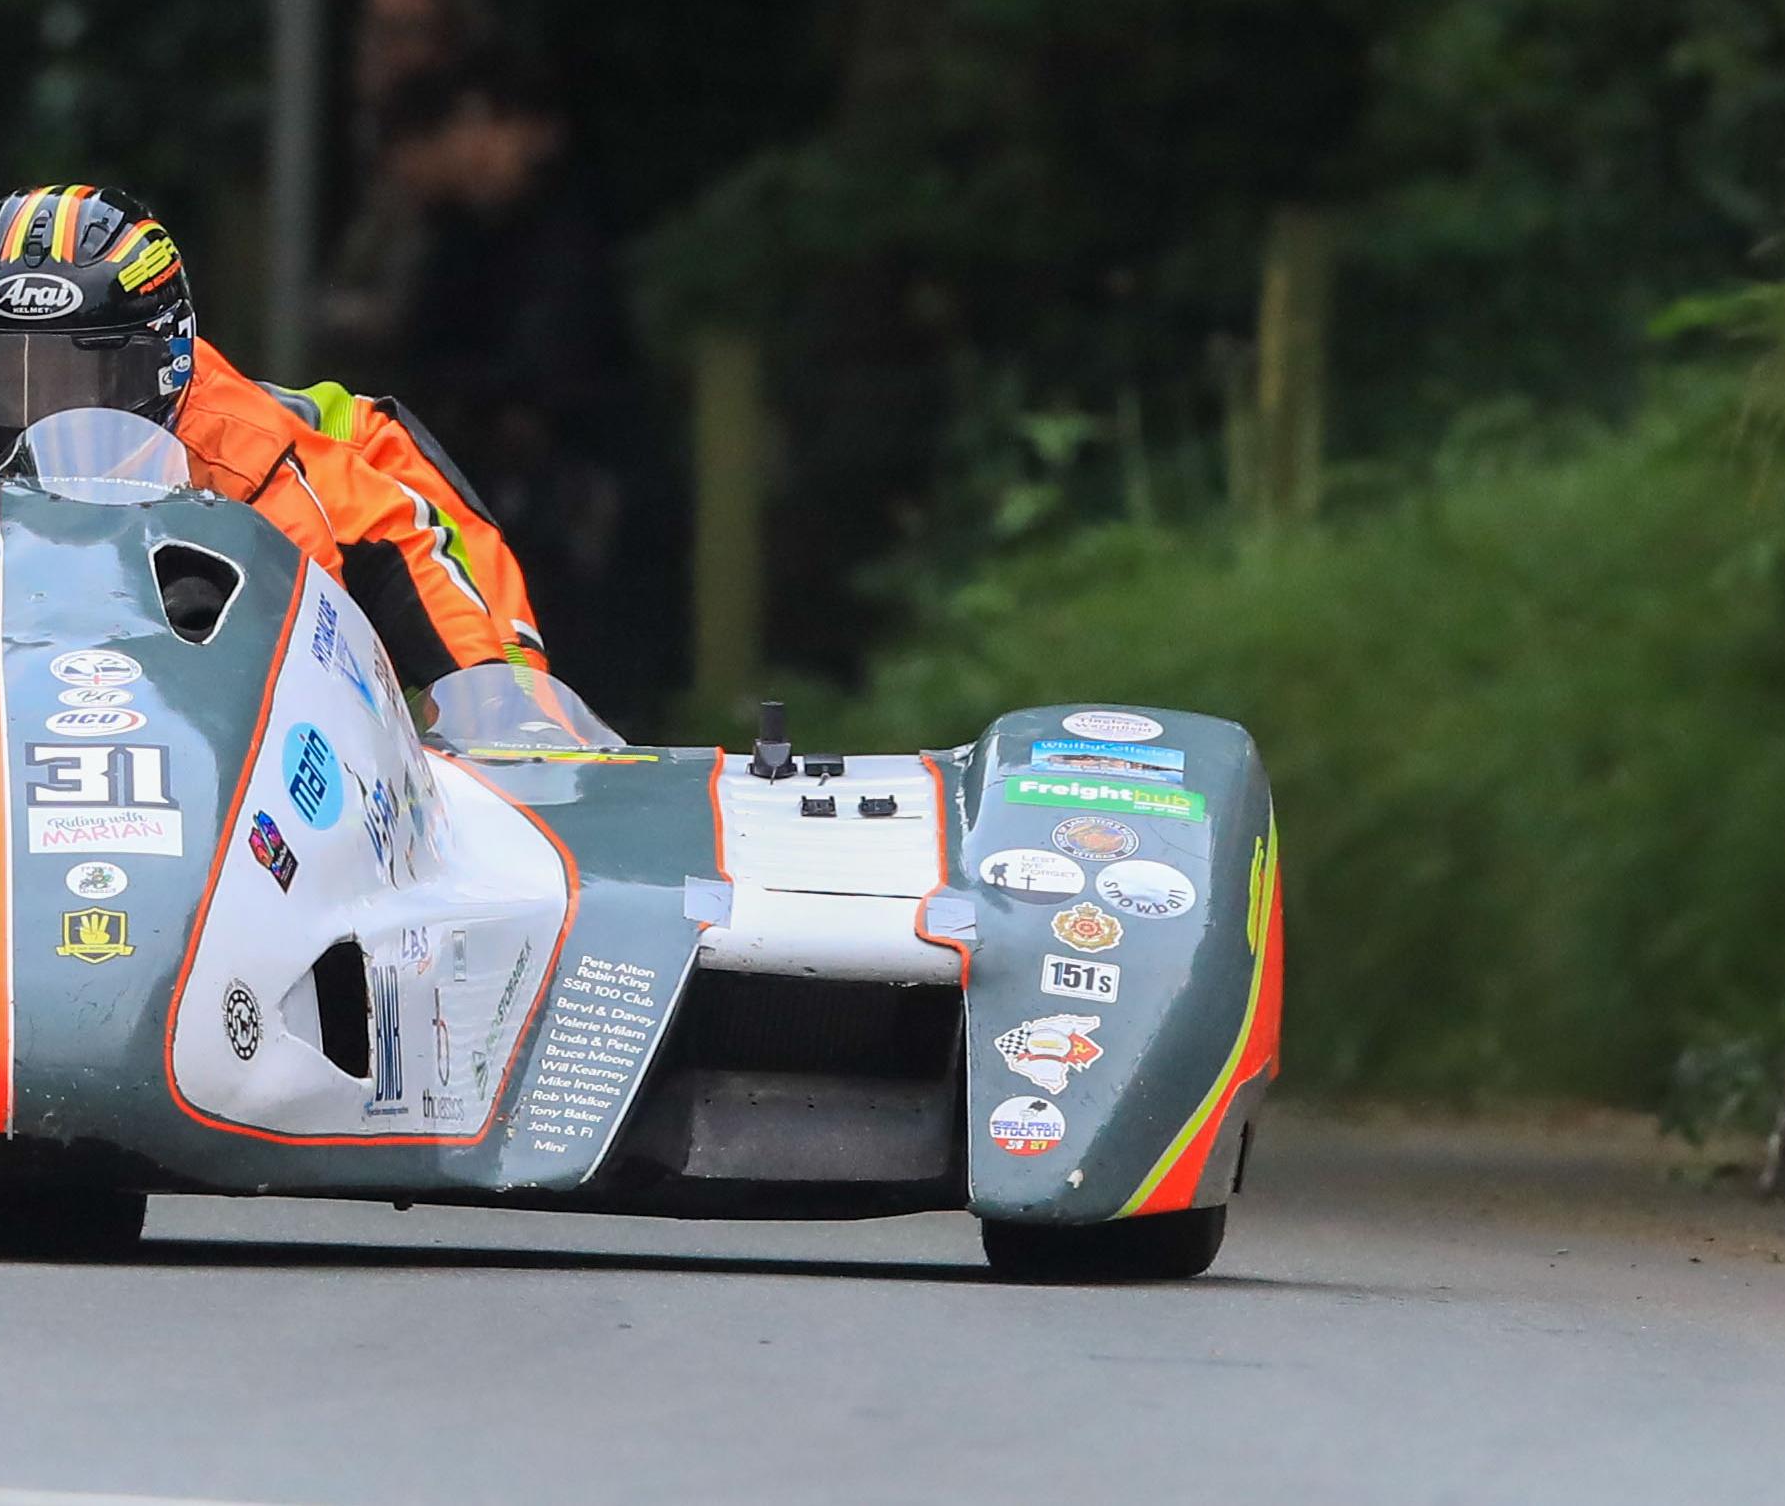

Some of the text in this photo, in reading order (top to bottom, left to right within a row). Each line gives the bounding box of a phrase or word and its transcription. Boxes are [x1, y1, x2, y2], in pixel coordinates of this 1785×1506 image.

[12, 305, 52, 315] HELMET
[56, 713, 121, 724] ACU
[27, 743, 177, 808] 31
[289, 729, 329, 823] marin
[47, 815, 105, 832] Riding
[42, 822, 164, 847] MARIAN
[1021, 862, 1044, 870] WE
[1022, 855, 1058, 864] LEST
[1020, 868, 1079, 878] FORGET
[1104, 880, 1187, 914] snowball
[581, 955, 656, 979] Pete Alton
[577, 966, 651, 992] Robin King
[562, 977, 654, 1007] SSR 100 Club
[554, 1013, 601, 1032] Valerie
[596, 1006, 607, 1017] &
[611, 1008, 656, 1028] Davey
[549, 1028, 644, 1054] Linda & Peter
[545, 1044, 635, 1068] Bruce Moore
[541, 1058, 629, 1083] Will Kearney
[537, 1075, 572, 1088] Mike
[532, 1090, 613, 1109] Rob Walker
[529, 1104, 604, 1123] Tony Baker
[527, 1121, 562, 1135] John
[564, 1125, 576, 1136] &
[534, 1140, 568, 1153] Mini
